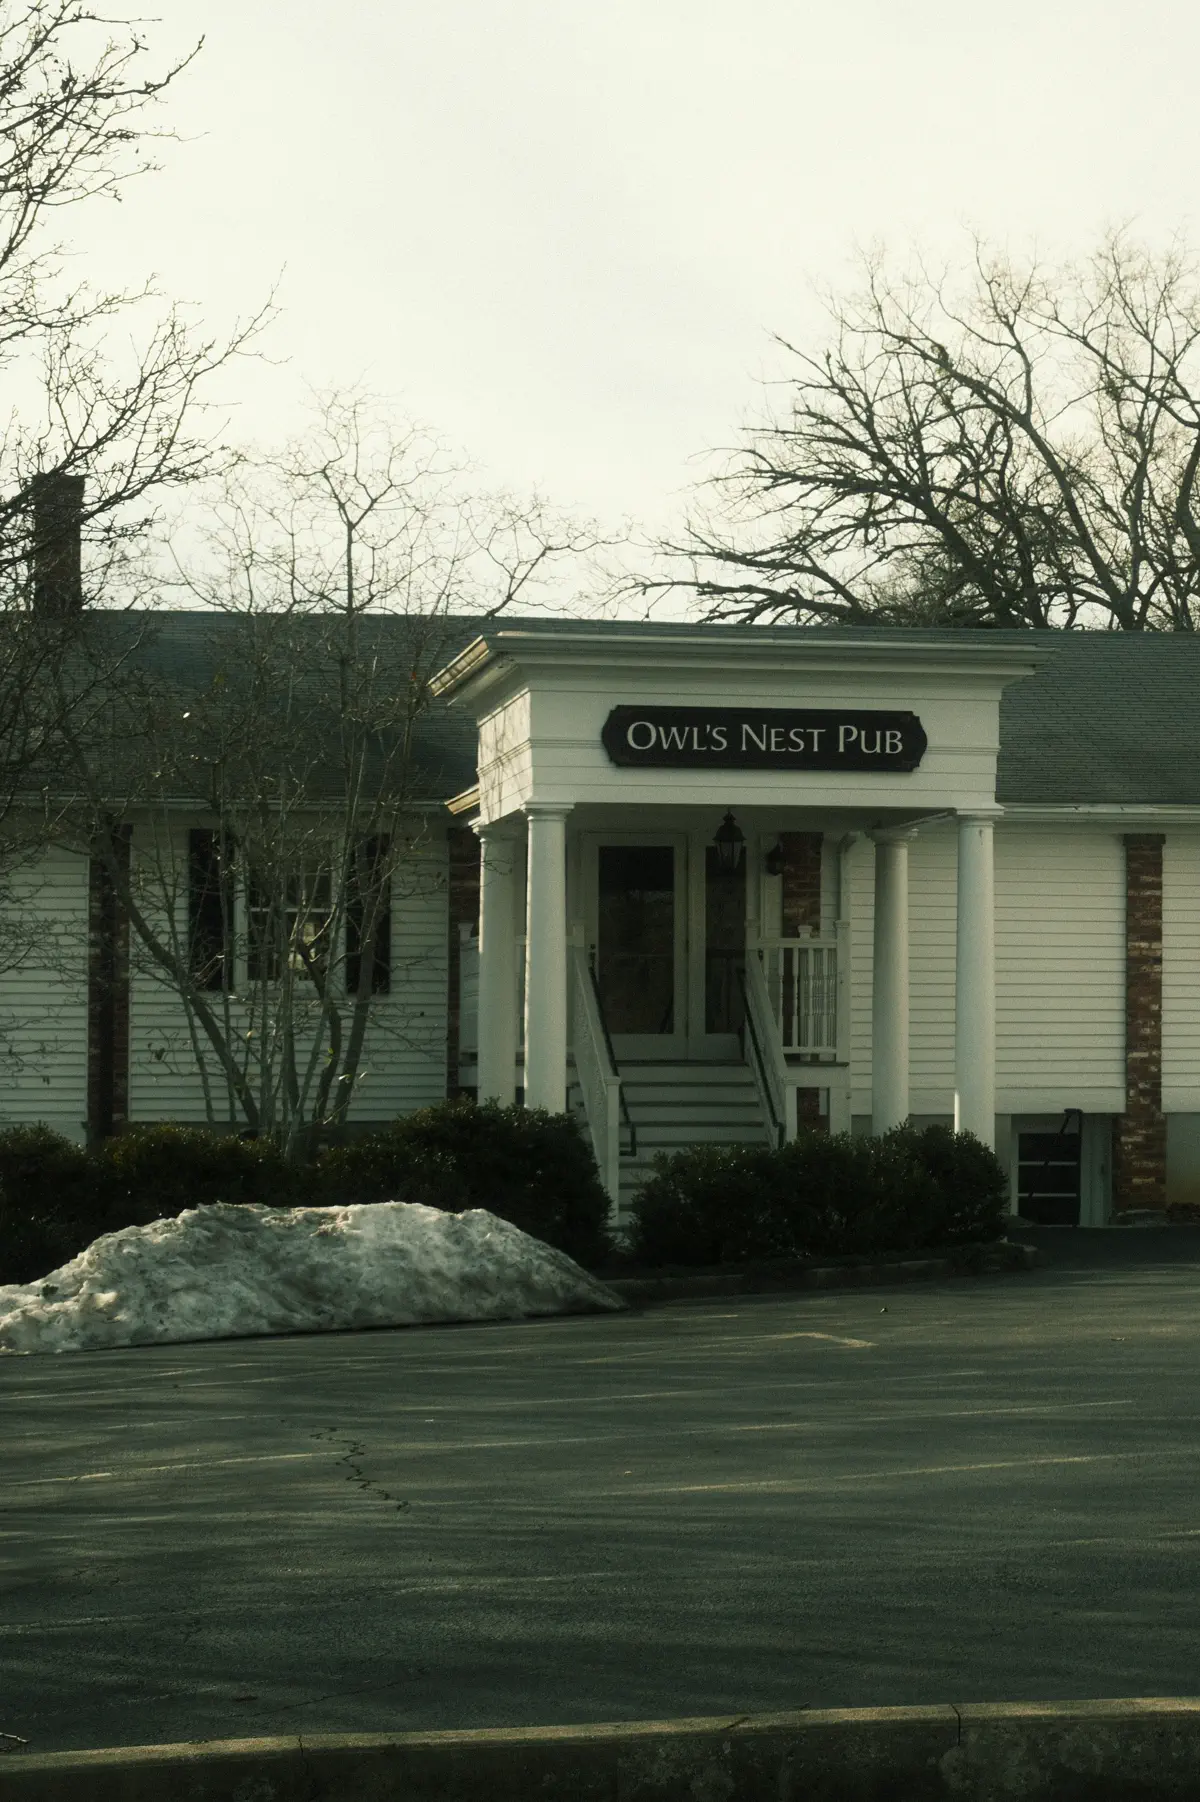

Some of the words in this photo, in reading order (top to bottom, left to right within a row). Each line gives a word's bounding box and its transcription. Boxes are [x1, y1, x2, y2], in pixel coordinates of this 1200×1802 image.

[627, 721, 728, 750] OWL'S
[741, 723, 827, 752] NEST
[838, 725, 904, 754] PUB
